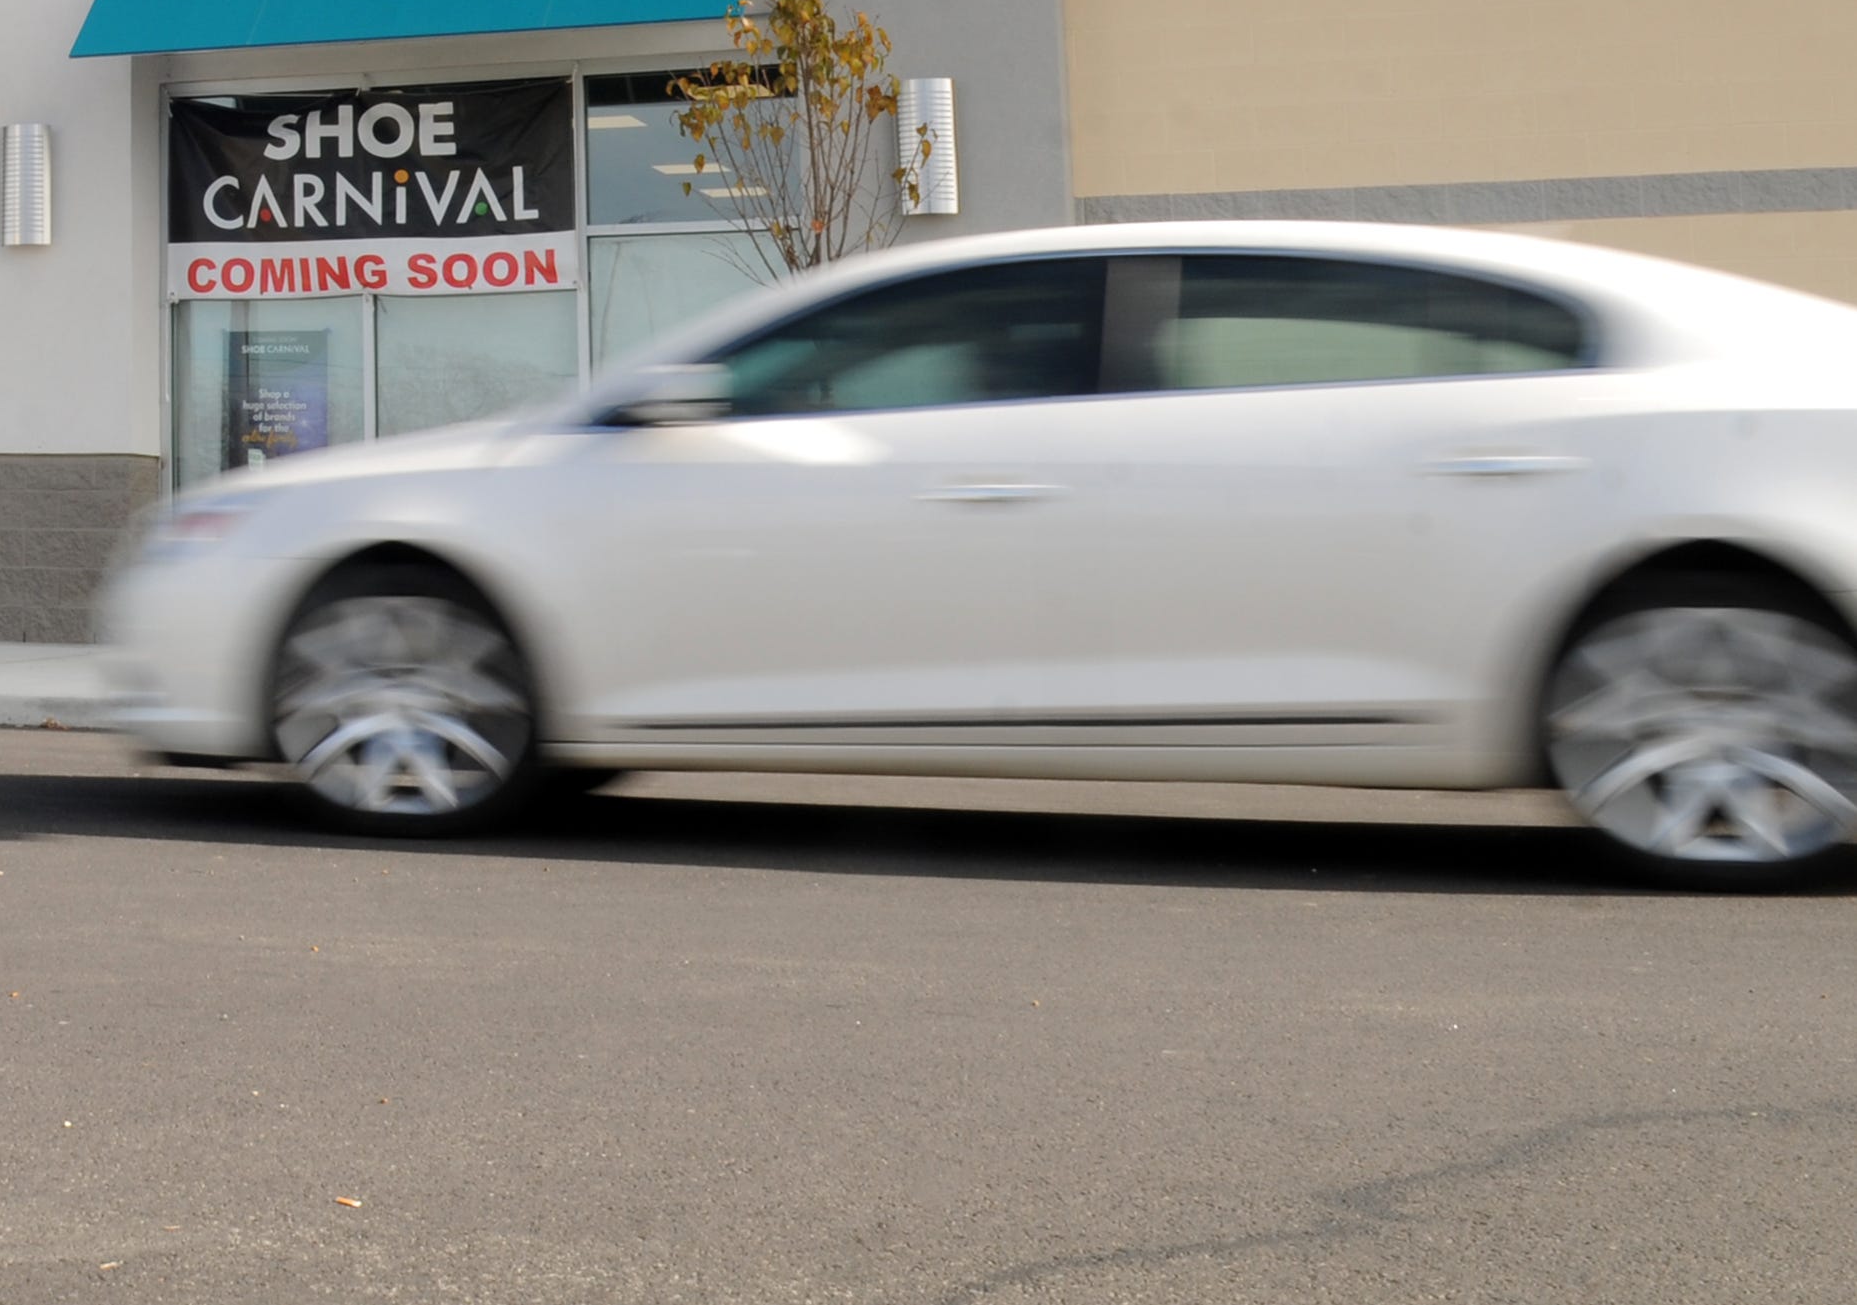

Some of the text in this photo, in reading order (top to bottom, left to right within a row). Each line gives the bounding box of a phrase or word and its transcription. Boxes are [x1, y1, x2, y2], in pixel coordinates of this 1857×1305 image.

[263, 102, 457, 160] SHOE
[187, 249, 558, 293] COMING SOON
[241, 345, 265, 354] SHOE
[258, 388, 282, 400] Shop
[242, 400, 307, 412] huge selection
[252, 411, 296, 422] of brands
[259, 423, 290, 433] for the
